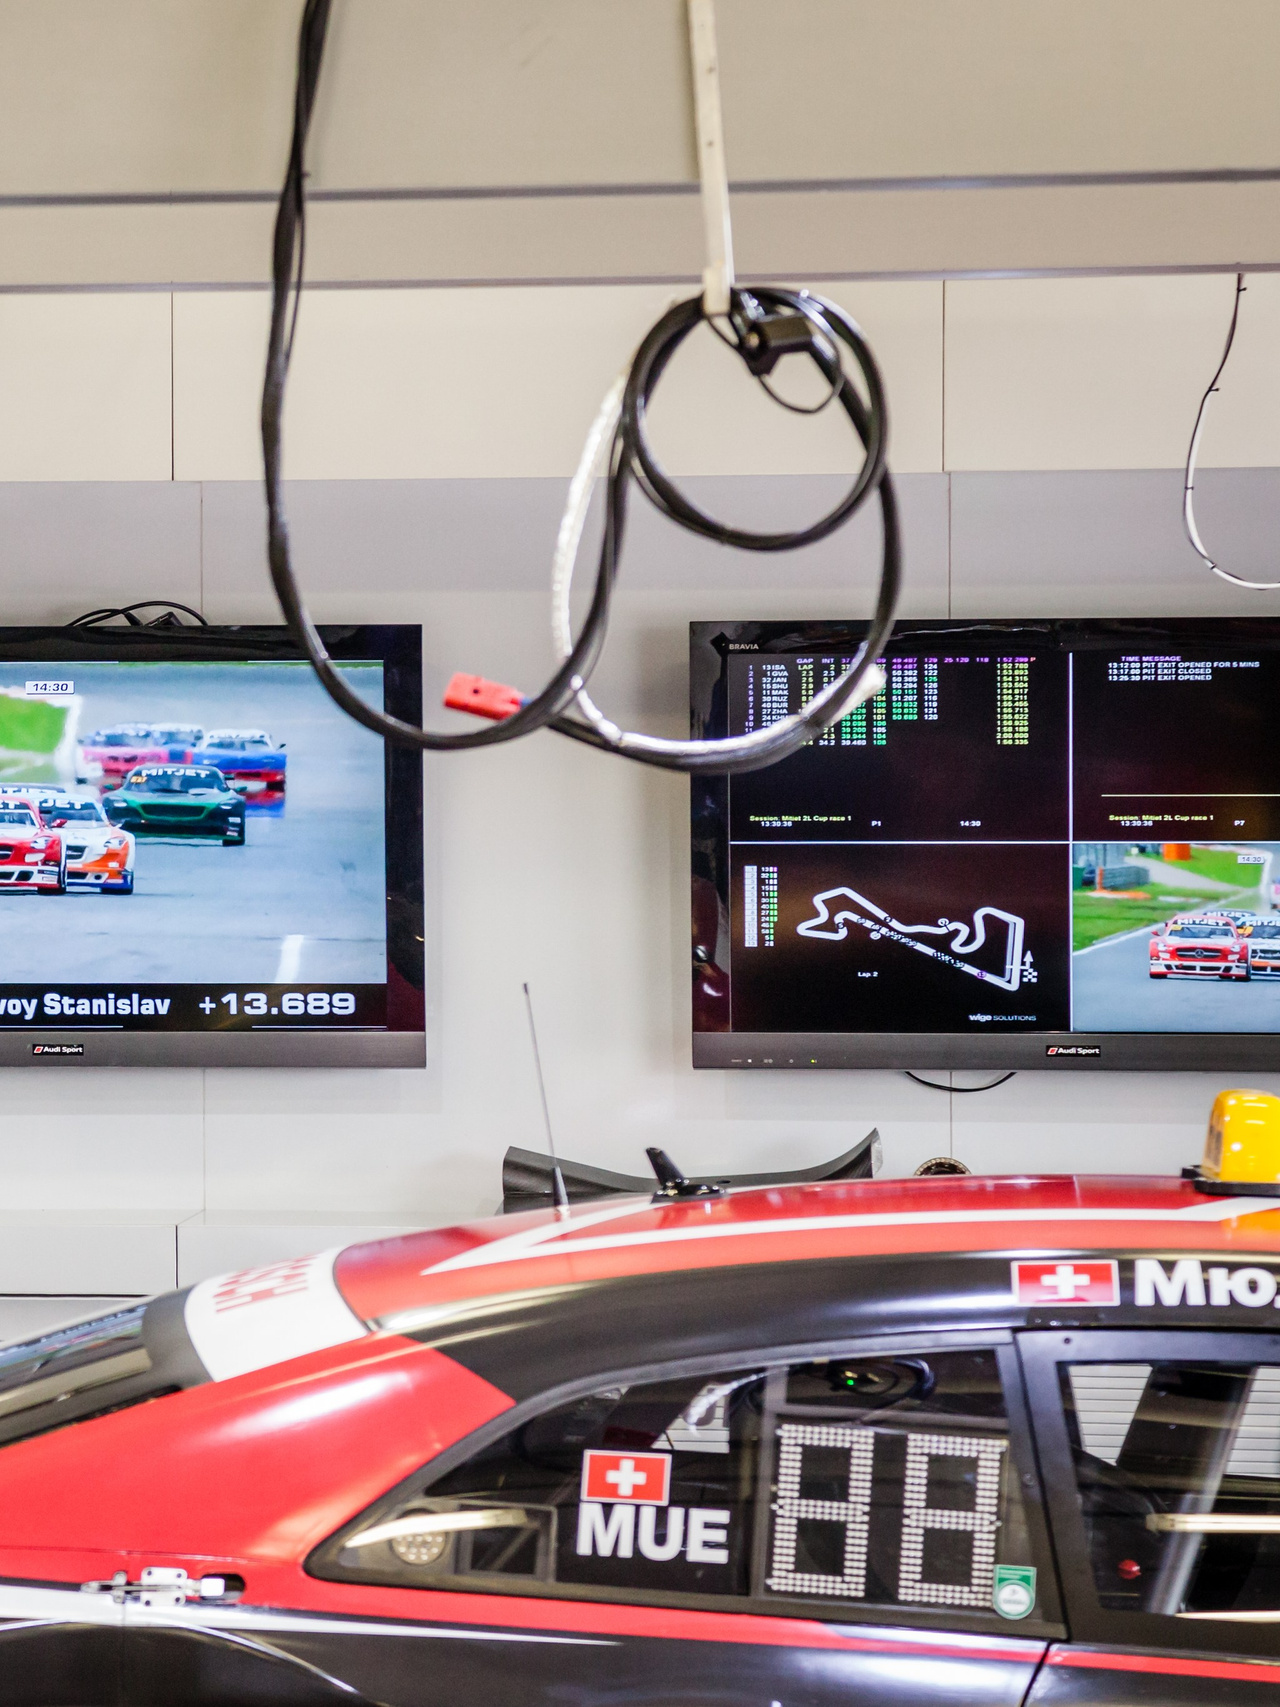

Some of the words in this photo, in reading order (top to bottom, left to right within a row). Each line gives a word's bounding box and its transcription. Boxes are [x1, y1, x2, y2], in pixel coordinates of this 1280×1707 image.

[32, 683, 69, 691] 14:30
[141, 768, 210, 778] MITJET
[1177, 918, 1227, 926] MITJET
[44, 993, 171, 1016] Stanislav
[199, 992, 357, 1016] +13.689
[43, 1045, 61, 1053] Audi
[62, 1045, 83, 1054] Sport
[1057, 1046, 1076, 1054] Audi
[1077, 1046, 1100, 1055] Sport
[1134, 1259, 1280, 1309] Мю
[576, 1502, 731, 1564] MUE
